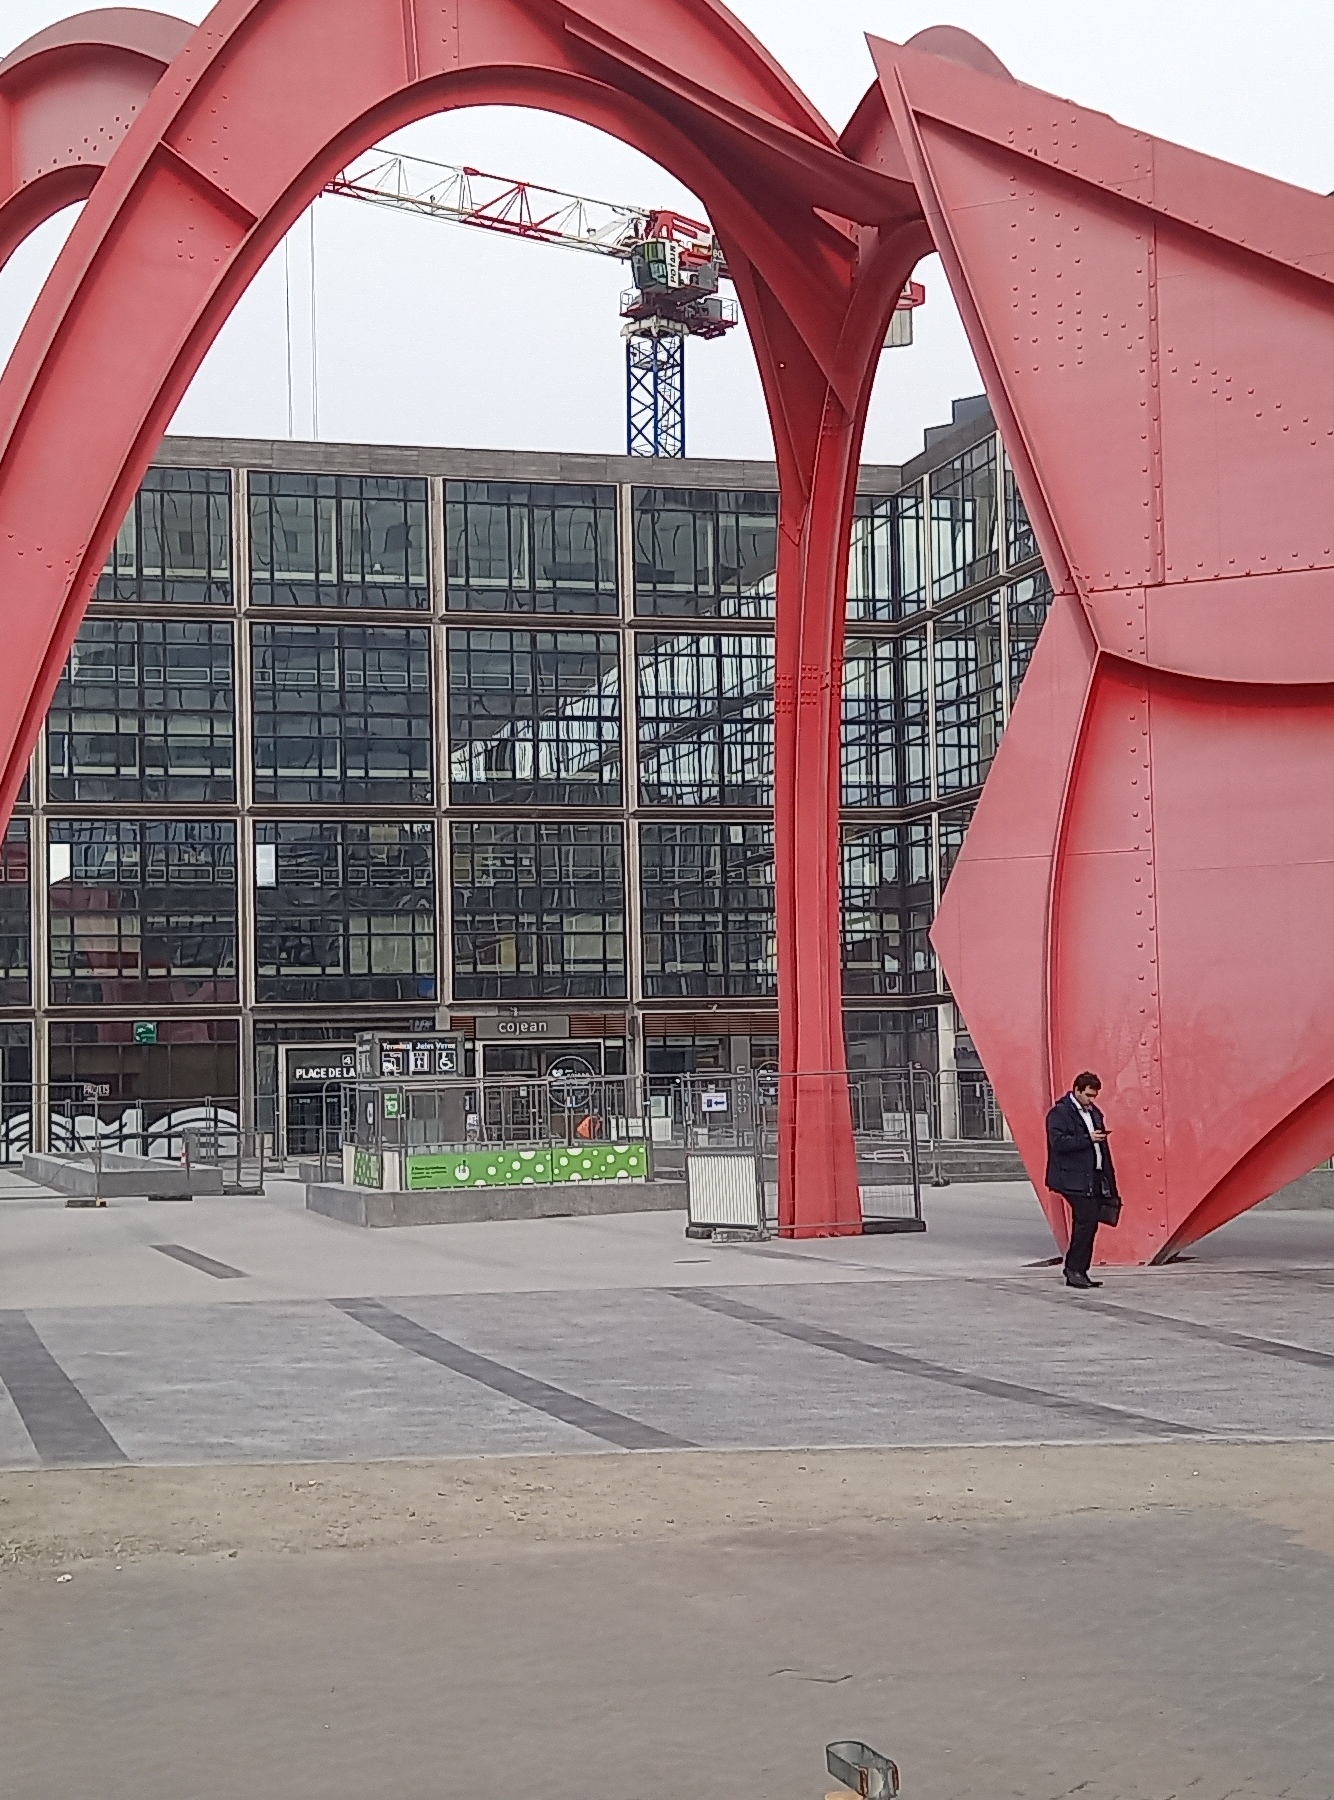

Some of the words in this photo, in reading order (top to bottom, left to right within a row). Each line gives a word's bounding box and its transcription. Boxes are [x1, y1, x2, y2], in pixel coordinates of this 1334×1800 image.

[498, 1021, 547, 1034] cojean
[295, 1067, 328, 1079] PLACE
[328, 1067, 342, 1078] DE
[342, 1067, 357, 1078] LA
